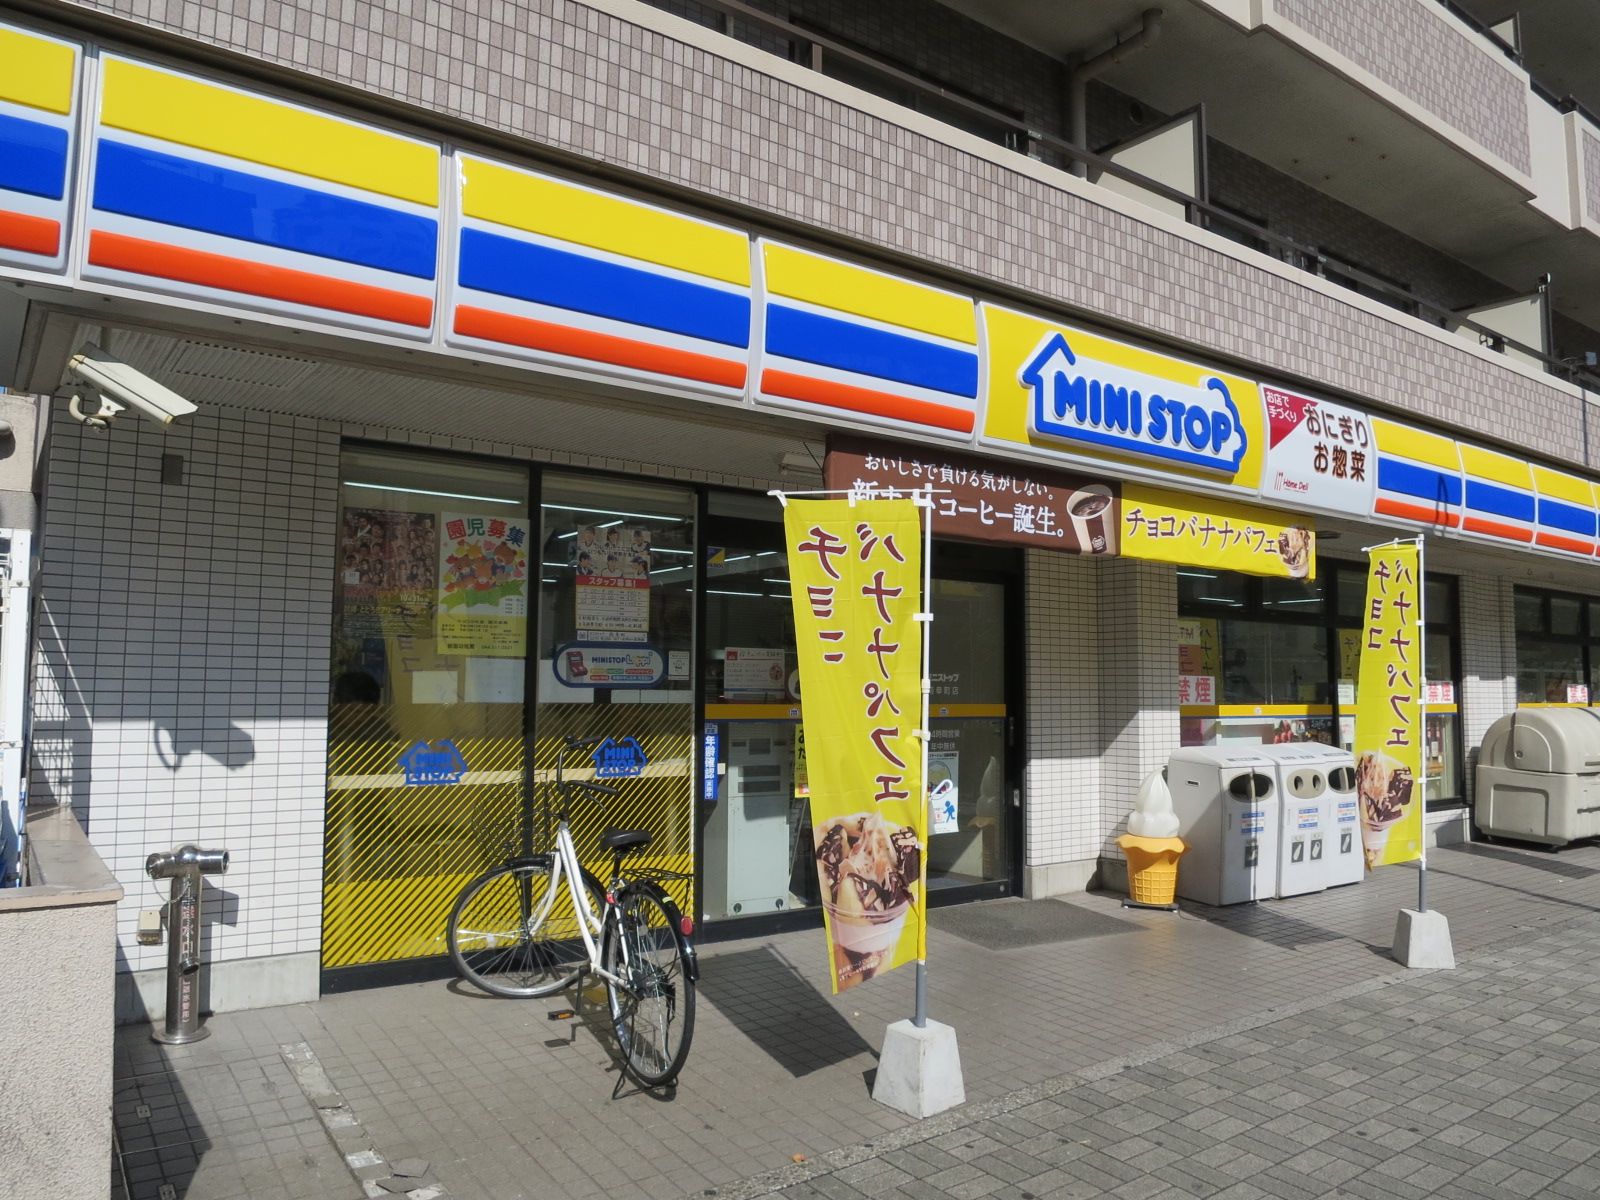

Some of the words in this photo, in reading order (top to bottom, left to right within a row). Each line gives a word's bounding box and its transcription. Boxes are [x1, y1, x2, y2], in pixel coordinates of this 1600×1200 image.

[1265, 390, 1290, 408] お店で
[1268, 405, 1298, 423] 手づくり
[1303, 402, 1369, 449] おにぎり
[864, 452, 1054, 501] おいしさで負ける気がしない。
[1313, 440, 1366, 483] お惣菜
[1126, 508, 1279, 554] チョコバナナパフェ
[929, 673, 960, 682] ニストップ
